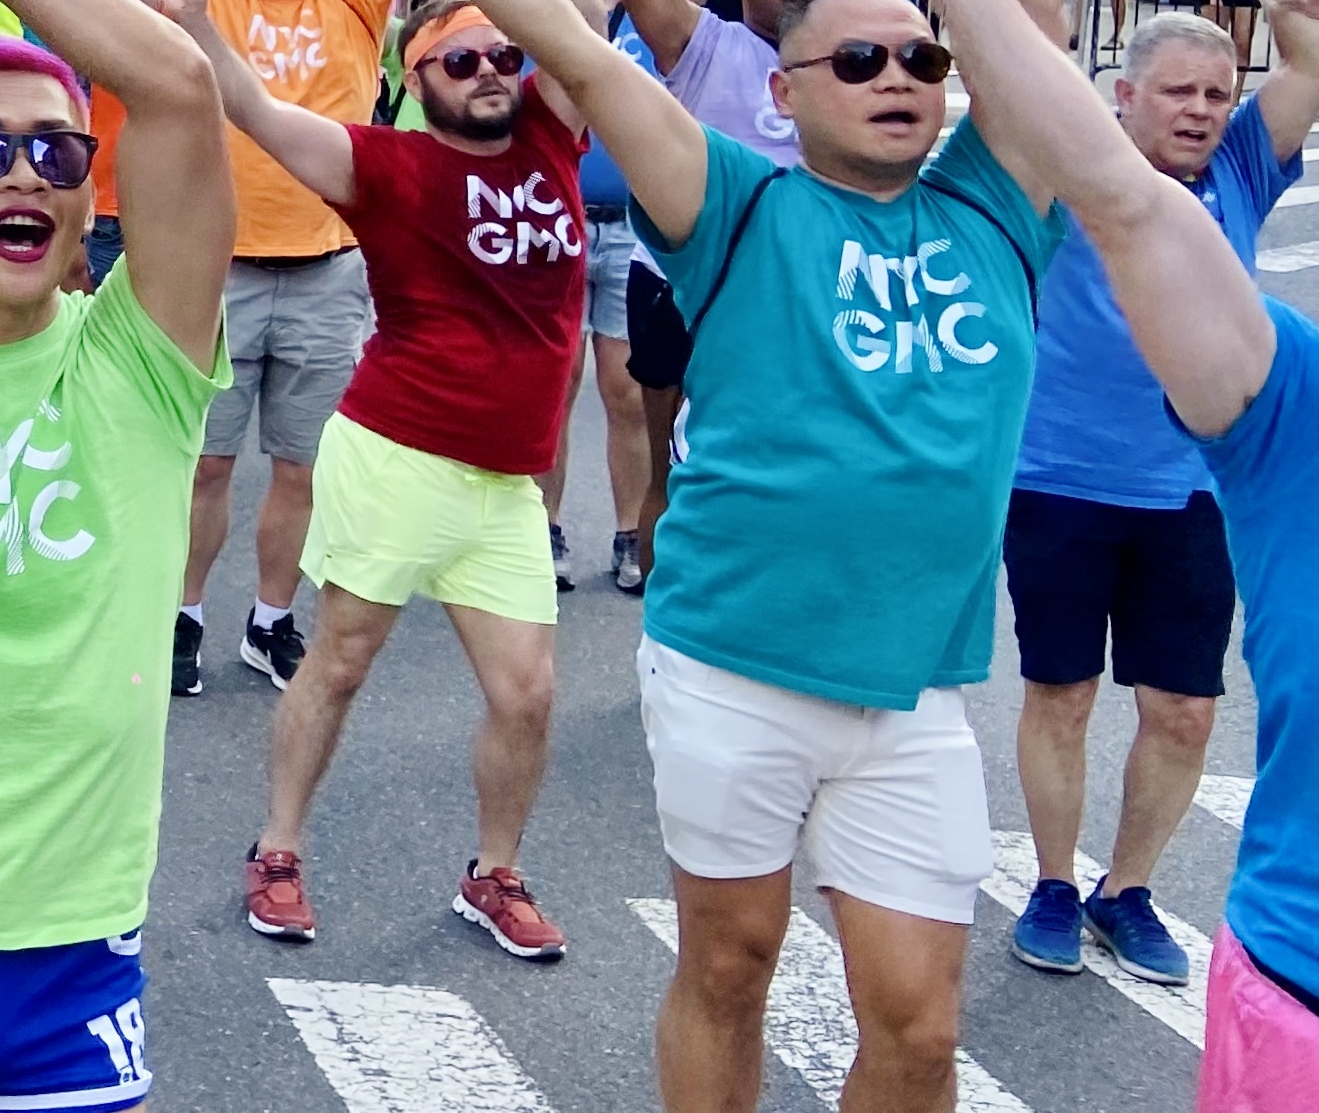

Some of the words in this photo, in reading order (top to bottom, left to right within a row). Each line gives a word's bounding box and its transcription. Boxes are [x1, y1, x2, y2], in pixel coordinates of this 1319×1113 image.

[247, 8, 322, 52] NYC
[247, 41, 328, 84] GMC
[466, 213, 582, 265] GMC
[835, 238, 972, 312] NYC
[832, 301, 999, 374] GMC
